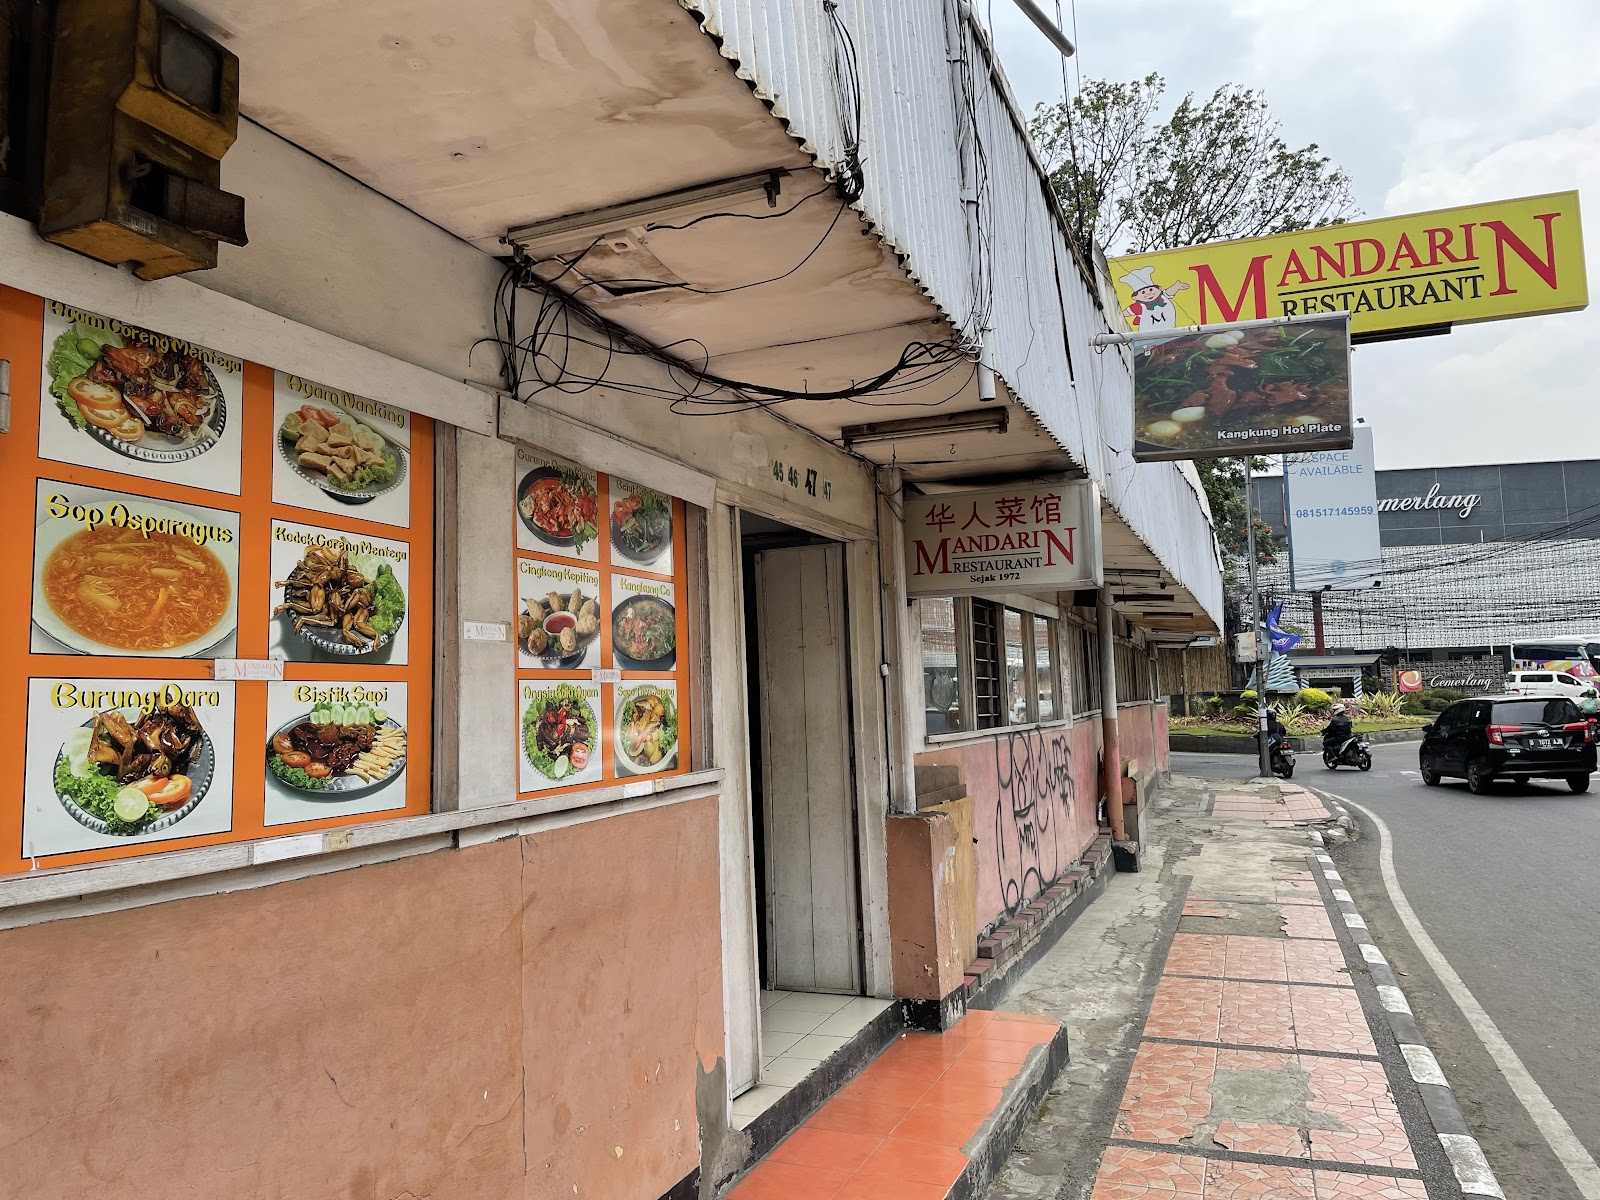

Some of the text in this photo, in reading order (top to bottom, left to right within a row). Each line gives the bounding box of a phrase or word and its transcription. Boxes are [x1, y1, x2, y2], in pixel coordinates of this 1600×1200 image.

[1188, 212, 1561, 324] MANDARIN
[1280, 274, 1485, 316] RESTAURANT
[286, 373, 339, 404] Ayam
[1217, 423, 1342, 440] Kangkung Hot Plate
[1299, 465, 1363, 477] AVAILABLE
[1311, 452, 1349, 463] SPACE
[773, 460, 831, 500] 45 46 47 47
[925, 493, 1061, 533] 华人菜馆
[1296, 506, 1374, 518] 081517145959
[1377, 482, 1481, 518] merlang
[45, 493, 233, 546] Sop Asparagus
[274, 527, 314, 545] Kodok
[360, 541, 407, 562] Mentega
[912, 527, 1077, 576] MANDARIN
[520, 561, 598, 587] Cingkong Kepiting
[953, 556, 1043, 574] RESTAURANT
[970, 572, 1020, 583] Sejak 1972
[620, 577, 659, 597] Kangkung
[294, 685, 388, 706] Bistik Sapi
[1430, 673, 1492, 691] Cemerlang
[50, 682, 220, 716] Burung Dara
